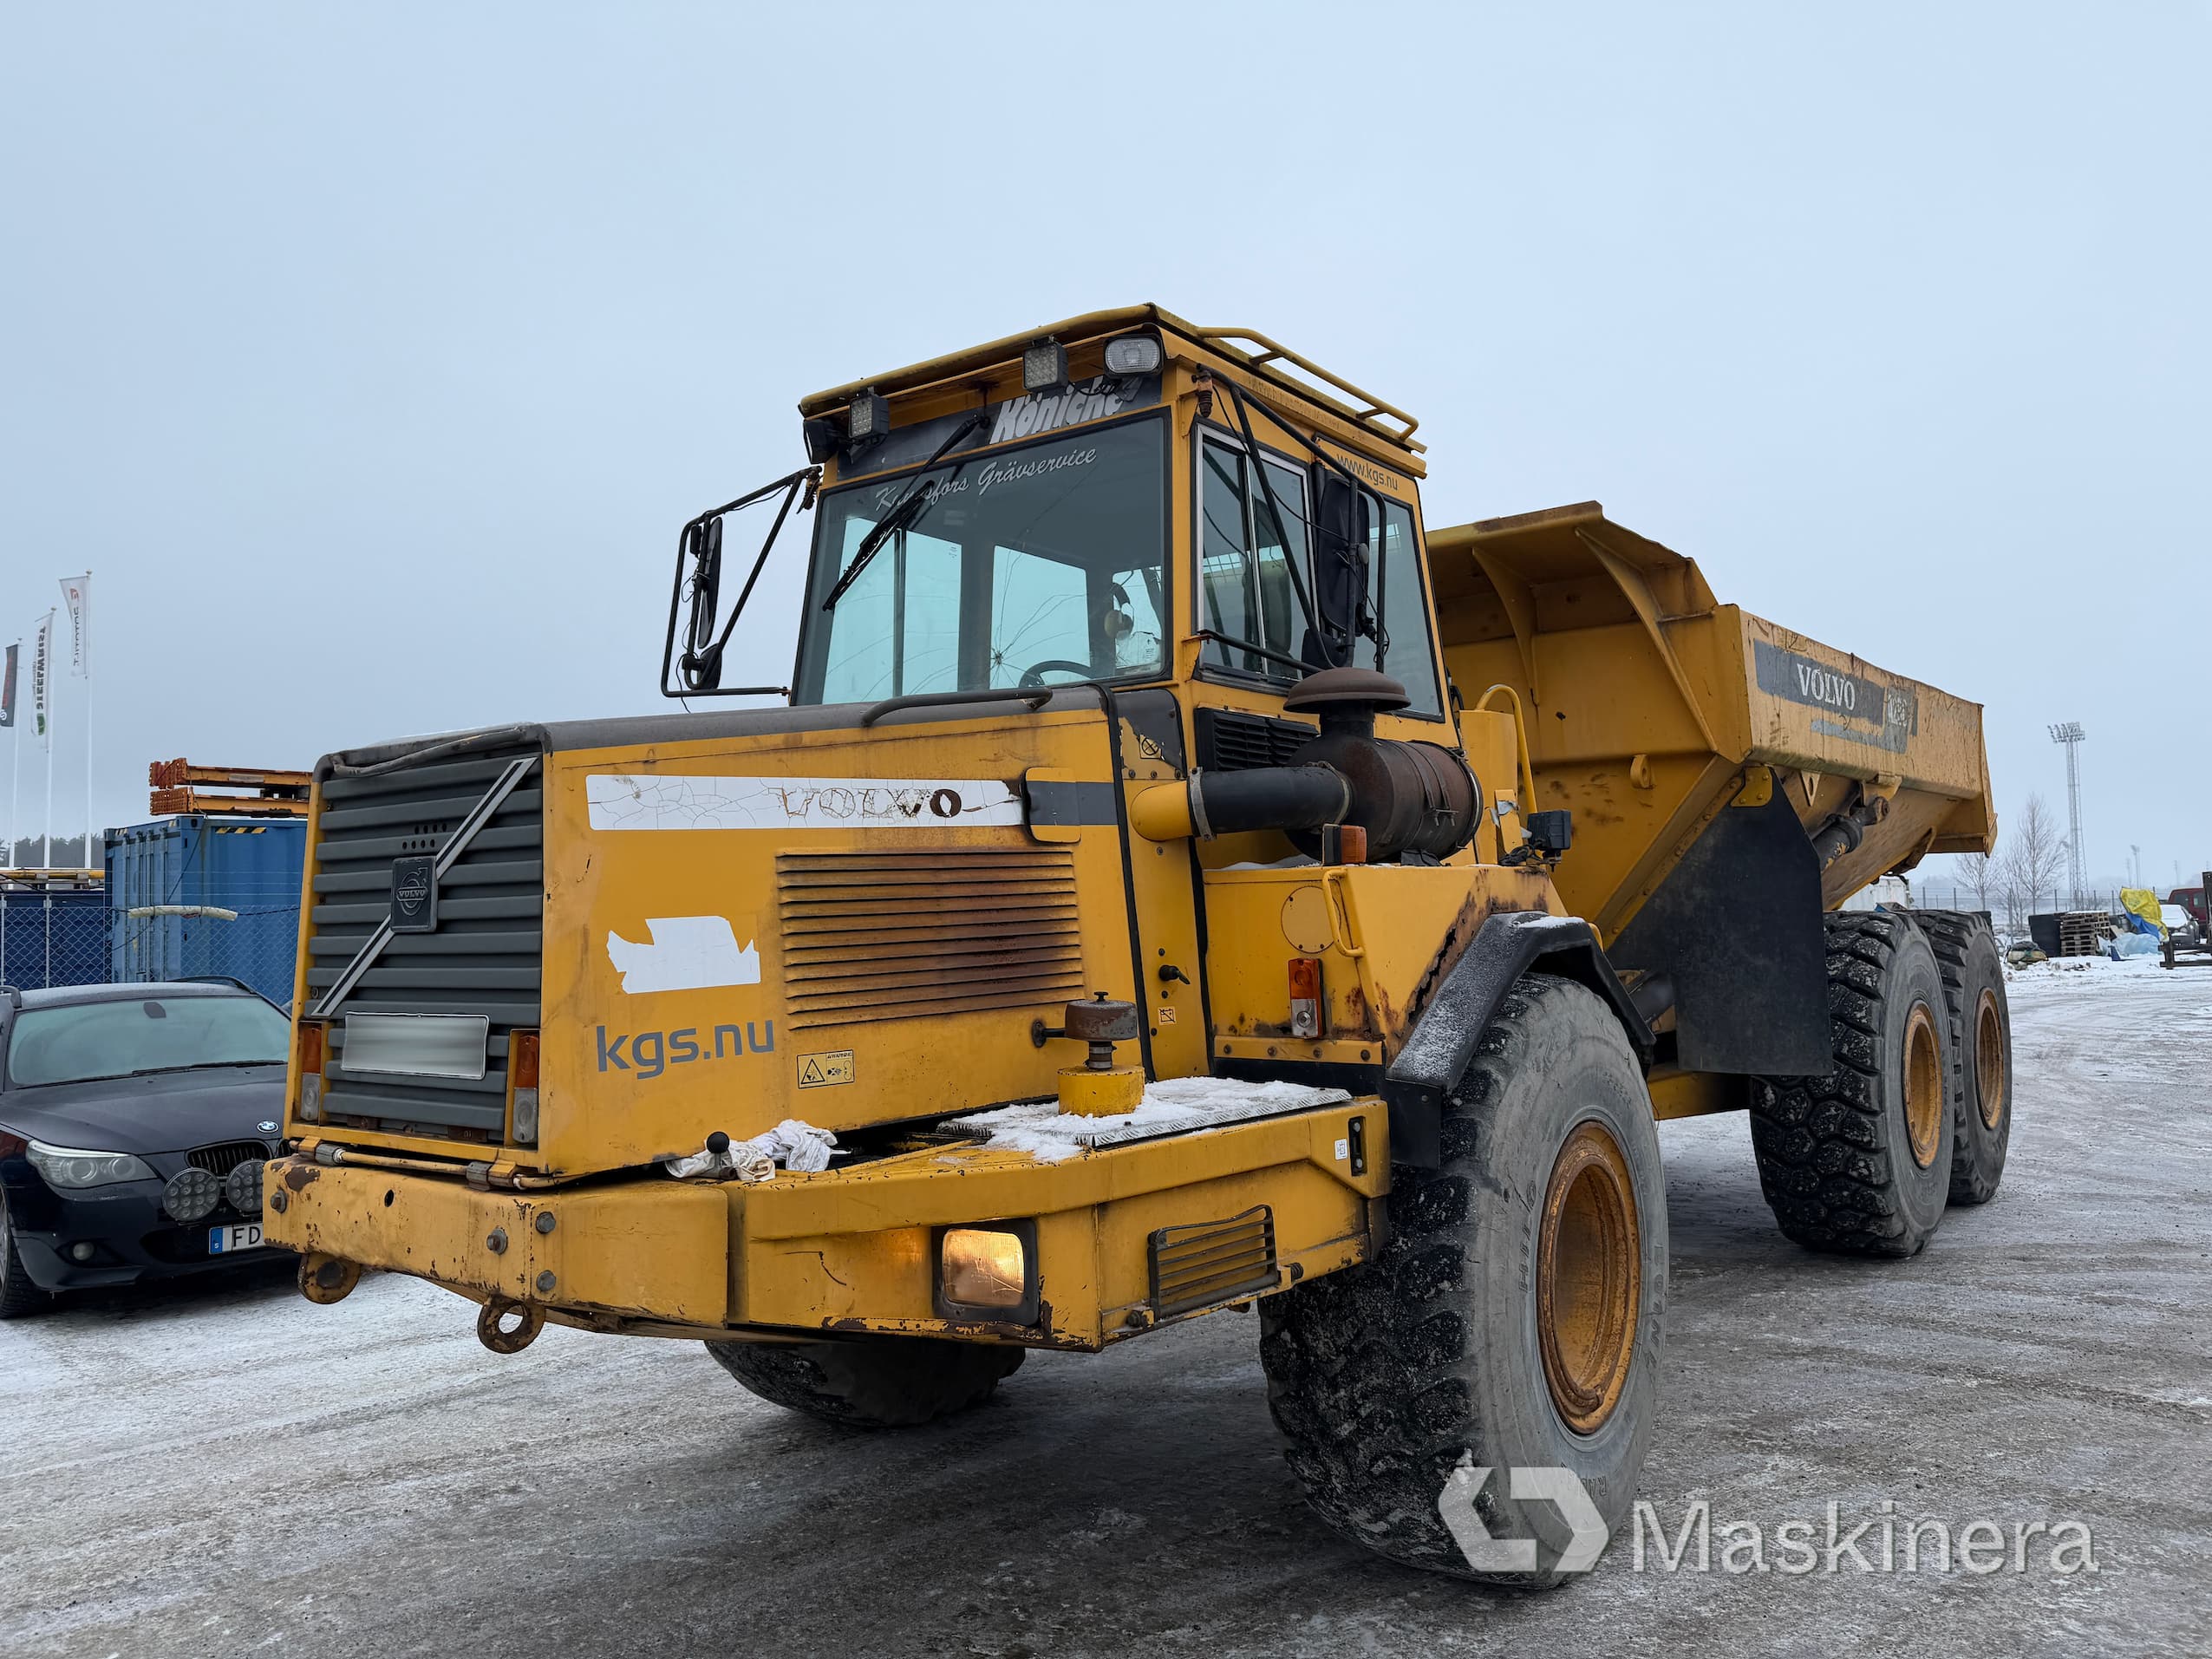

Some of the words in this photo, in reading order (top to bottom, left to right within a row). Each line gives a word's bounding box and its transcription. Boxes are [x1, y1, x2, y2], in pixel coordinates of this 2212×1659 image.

[977, 448, 1097, 496] Grävservice
[1336, 454, 1399, 492] www.kgs.nu
[1797, 663, 1856, 711] VOLVO
[770, 787, 962, 819] VOLVO
[596, 1019, 774, 1080] kgs.nu
